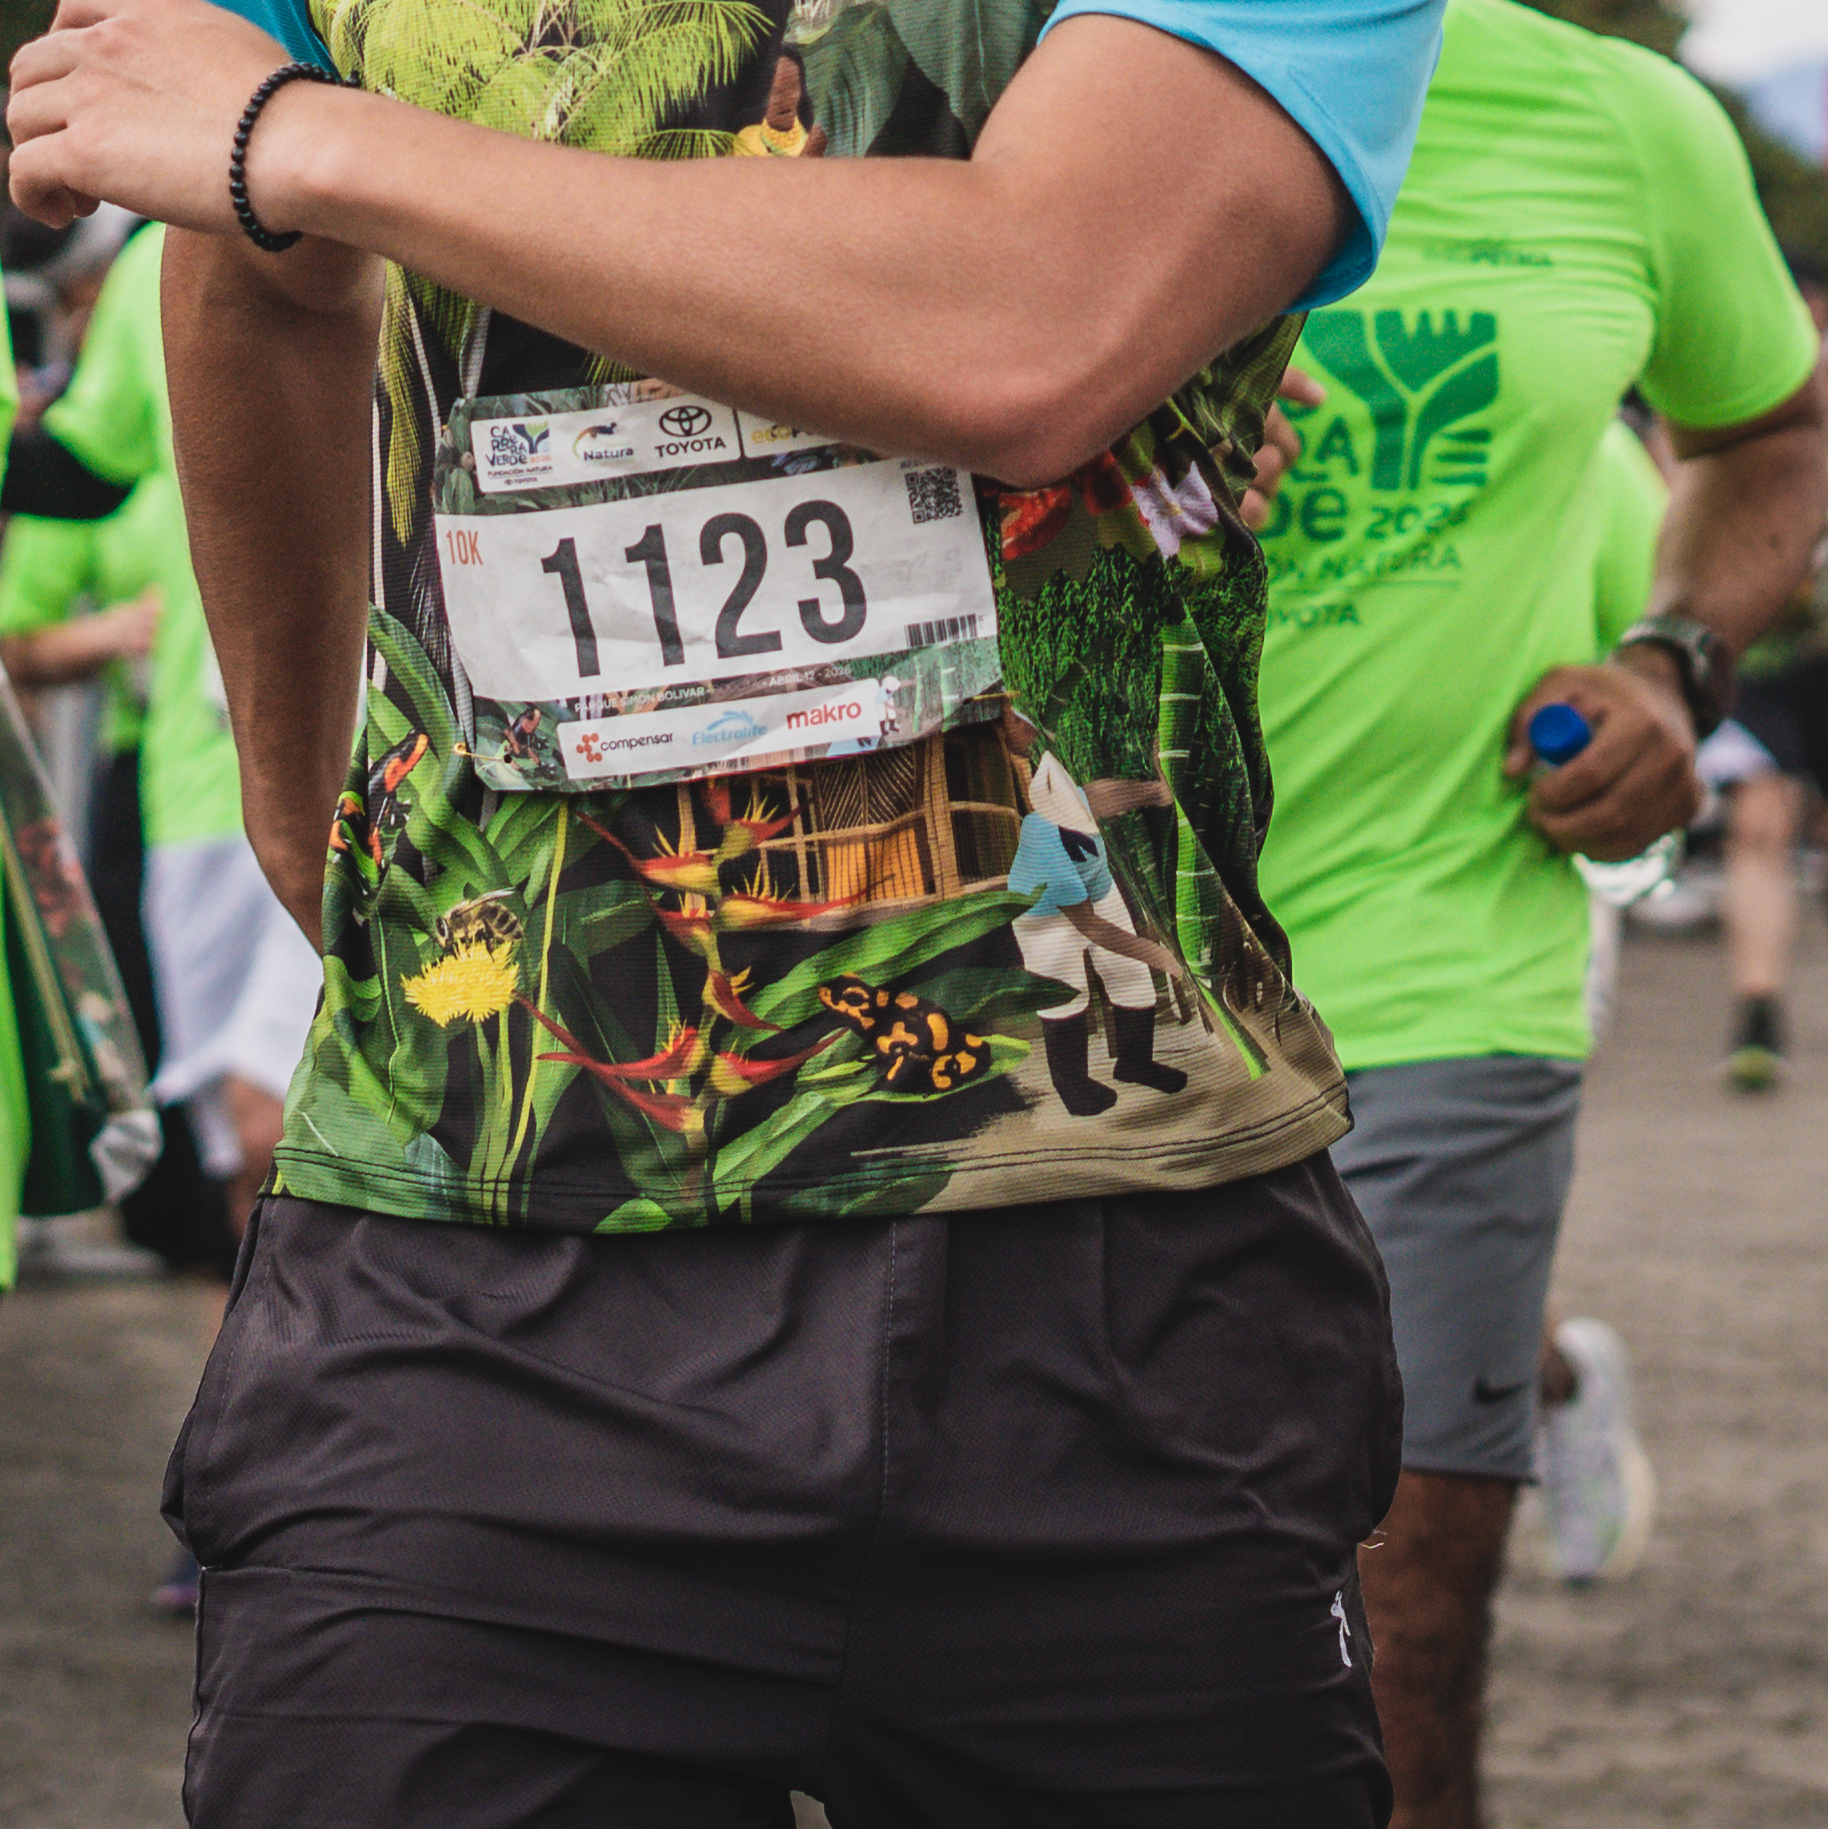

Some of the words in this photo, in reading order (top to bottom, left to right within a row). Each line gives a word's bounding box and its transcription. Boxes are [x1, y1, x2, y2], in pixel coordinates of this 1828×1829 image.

[583, 445, 634, 461] Natura
[655, 437, 727, 458] TOYOTA
[487, 467, 525, 477] FUNDACIÓN
[526, 465, 553, 474] NATURA
[513, 477, 539, 485] TOYOTA
[446, 529, 484, 566] 10K
[540, 499, 868, 679] 1123
[768, 670, 803, 687] ABRIL
[804, 671, 815, 681] 12
[825, 666, 852, 679] 2026
[575, 697, 619, 713] PARQUE
[657, 685, 705, 702] BOLIVAR
[786, 701, 862, 730] makro
[600, 732, 674, 751] compensar
